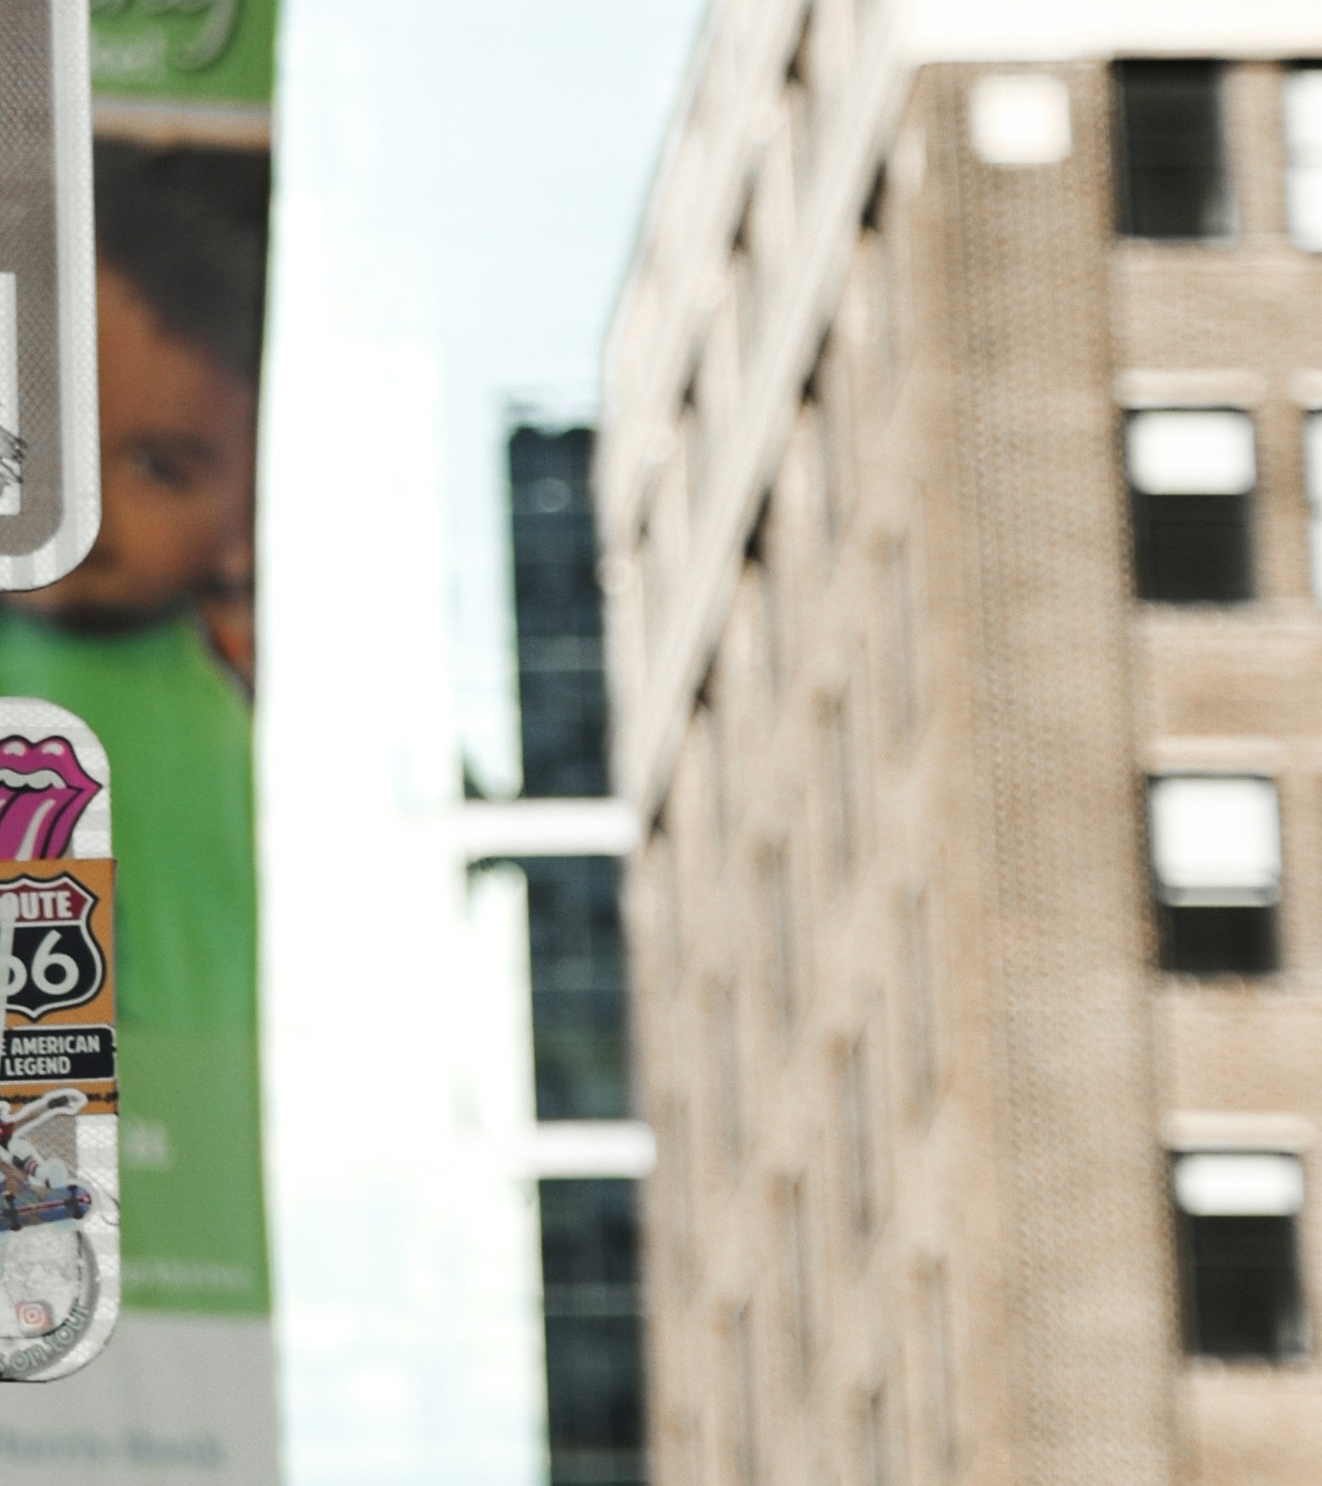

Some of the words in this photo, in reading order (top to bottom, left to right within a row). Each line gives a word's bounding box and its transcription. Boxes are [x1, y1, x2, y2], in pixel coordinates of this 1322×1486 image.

[10, 1034, 101, 1056] AMERICAN
[4, 1056, 72, 1076] LEGEND
[9, 1343, 47, 1372] on
